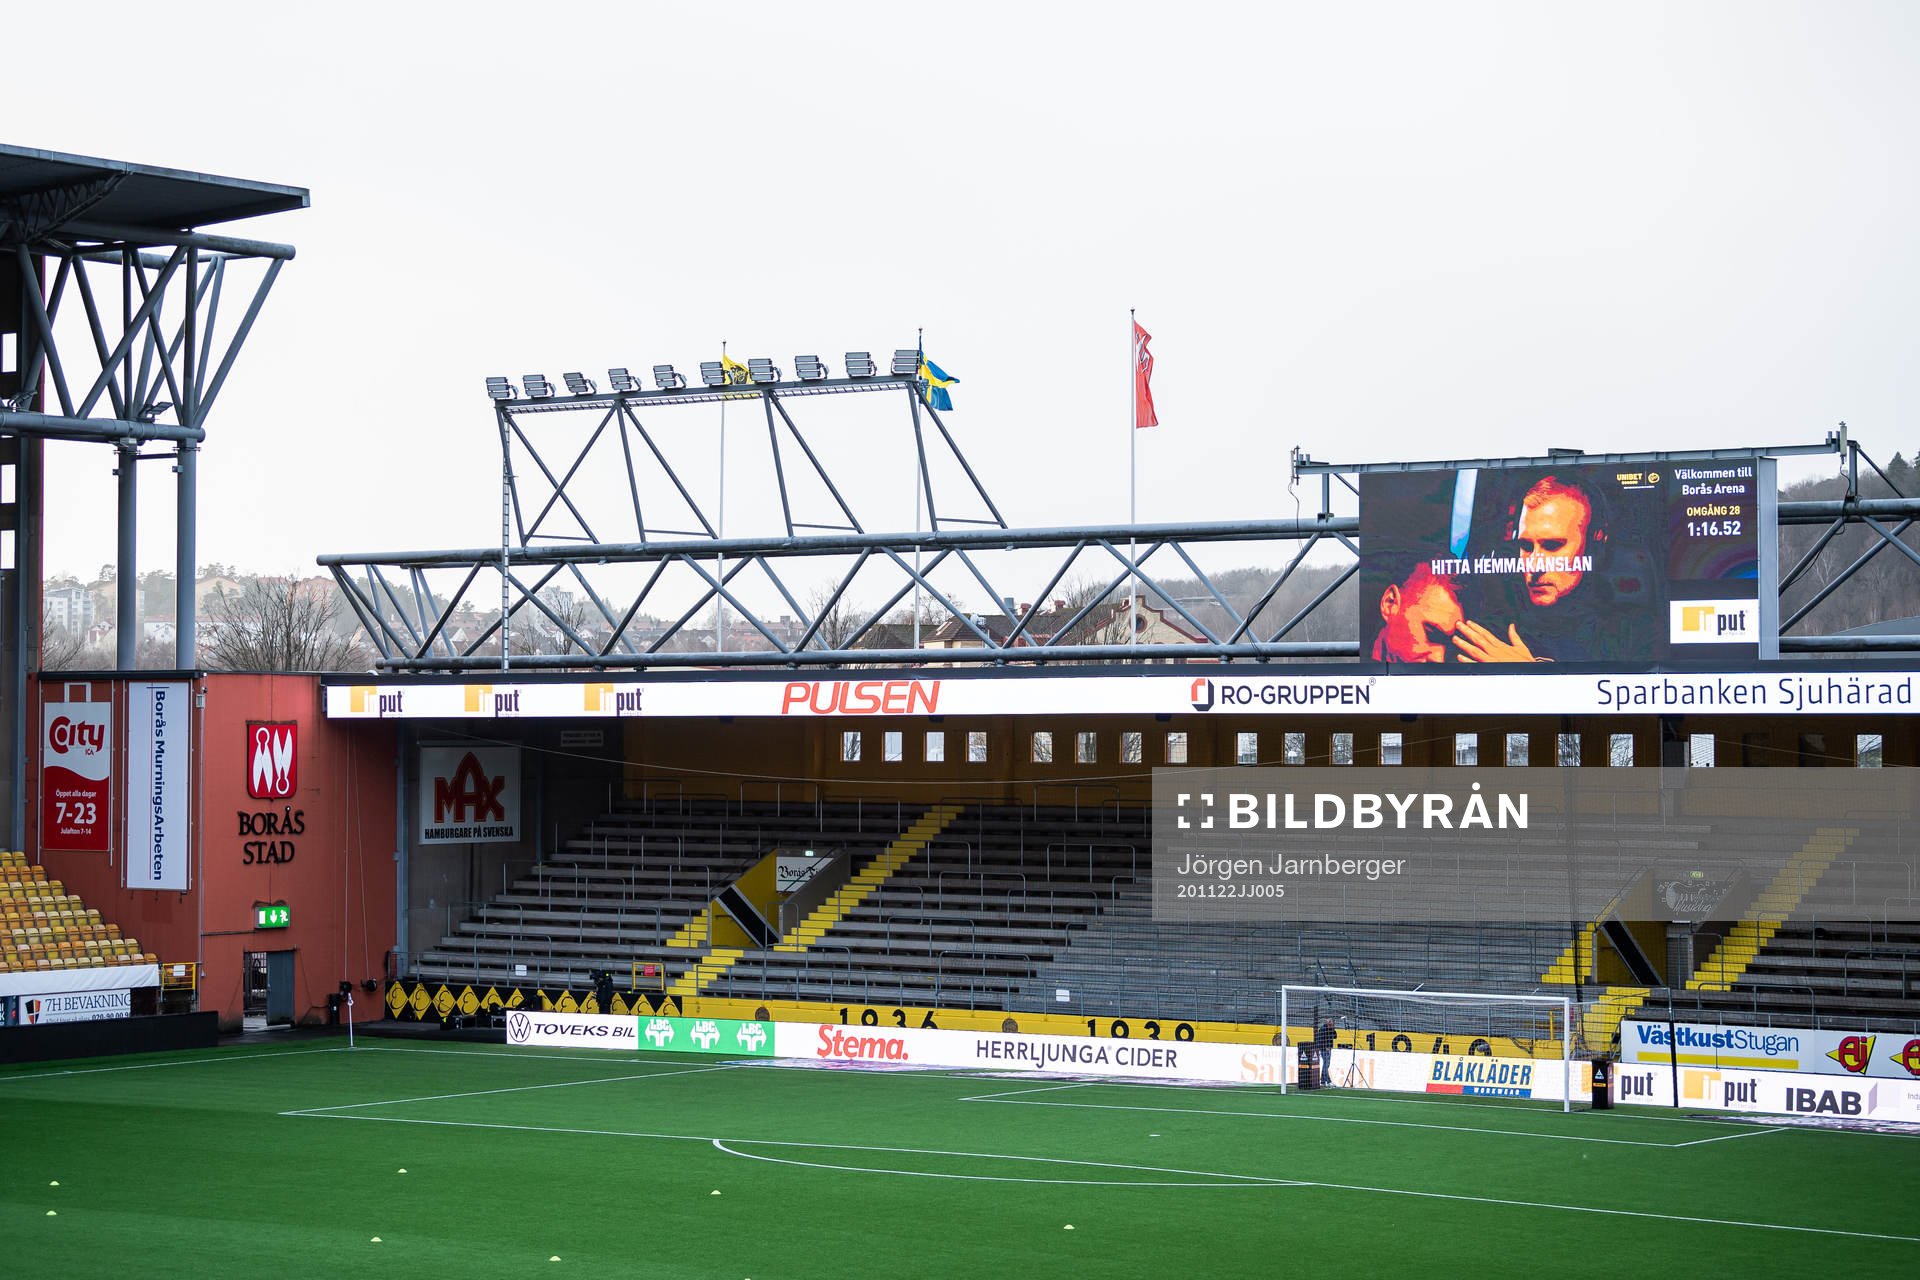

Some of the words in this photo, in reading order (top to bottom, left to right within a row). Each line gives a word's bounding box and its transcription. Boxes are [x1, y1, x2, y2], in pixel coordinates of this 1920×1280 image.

[1616, 473, 1643, 481] UNIBET
[1675, 468, 1735, 480] Välkommen
[1738, 466, 1752, 478] till
[1682, 482, 1712, 495] Borås
[1714, 483, 1745, 494] Arena
[1686, 504, 1727, 516] OMGÅNG
[1729, 506, 1741, 515] 28
[1687, 521, 1741, 536] 1:16.52
[1431, 559, 1471, 575] HITTA
[1474, 552, 1592, 574] HEMMAKÄNSLAN
[781, 681, 941, 714] PULSEN
[1597, 678, 1767, 711] Sparbanken
[1779, 677, 1912, 711] Sjuhärad
[154, 690, 167, 737] Borås
[49, 715, 105, 754] City
[82, 790, 96, 799] dagar
[434, 752, 505, 823] MAX
[56, 802, 97, 824] 7-23
[152, 740, 166, 880] MurningsArbeten
[238, 805, 305, 836] BORÅS
[424, 828, 472, 840] HAMBURGARE
[473, 825, 482, 838] PÅ
[483, 826, 514, 838] SVENSKA
[242, 840, 296, 865] STAD
[46, 998, 61, 1012] 7H
[534, 1023, 608, 1037] TOVEKS
[612, 1027, 636, 1038] BIL
[650, 1018, 670, 1032] LBC
[695, 1020, 716, 1034] LBC
[741, 1022, 762, 1036] LBC
[817, 1024, 909, 1061] Stema.
[1637, 1024, 1800, 1056] VästkustStugan
[976, 1039, 1109, 1069] HERRLJUNGA
[1115, 1047, 1177, 1069] CIDER
[1241, 1051, 1375, 1088] Sanall
[1432, 1057, 1533, 1086] BLÅKLÄDER
[1473, 1086, 1521, 1096] WORKWEAR
[1786, 1087, 1862, 1116] IBAB
